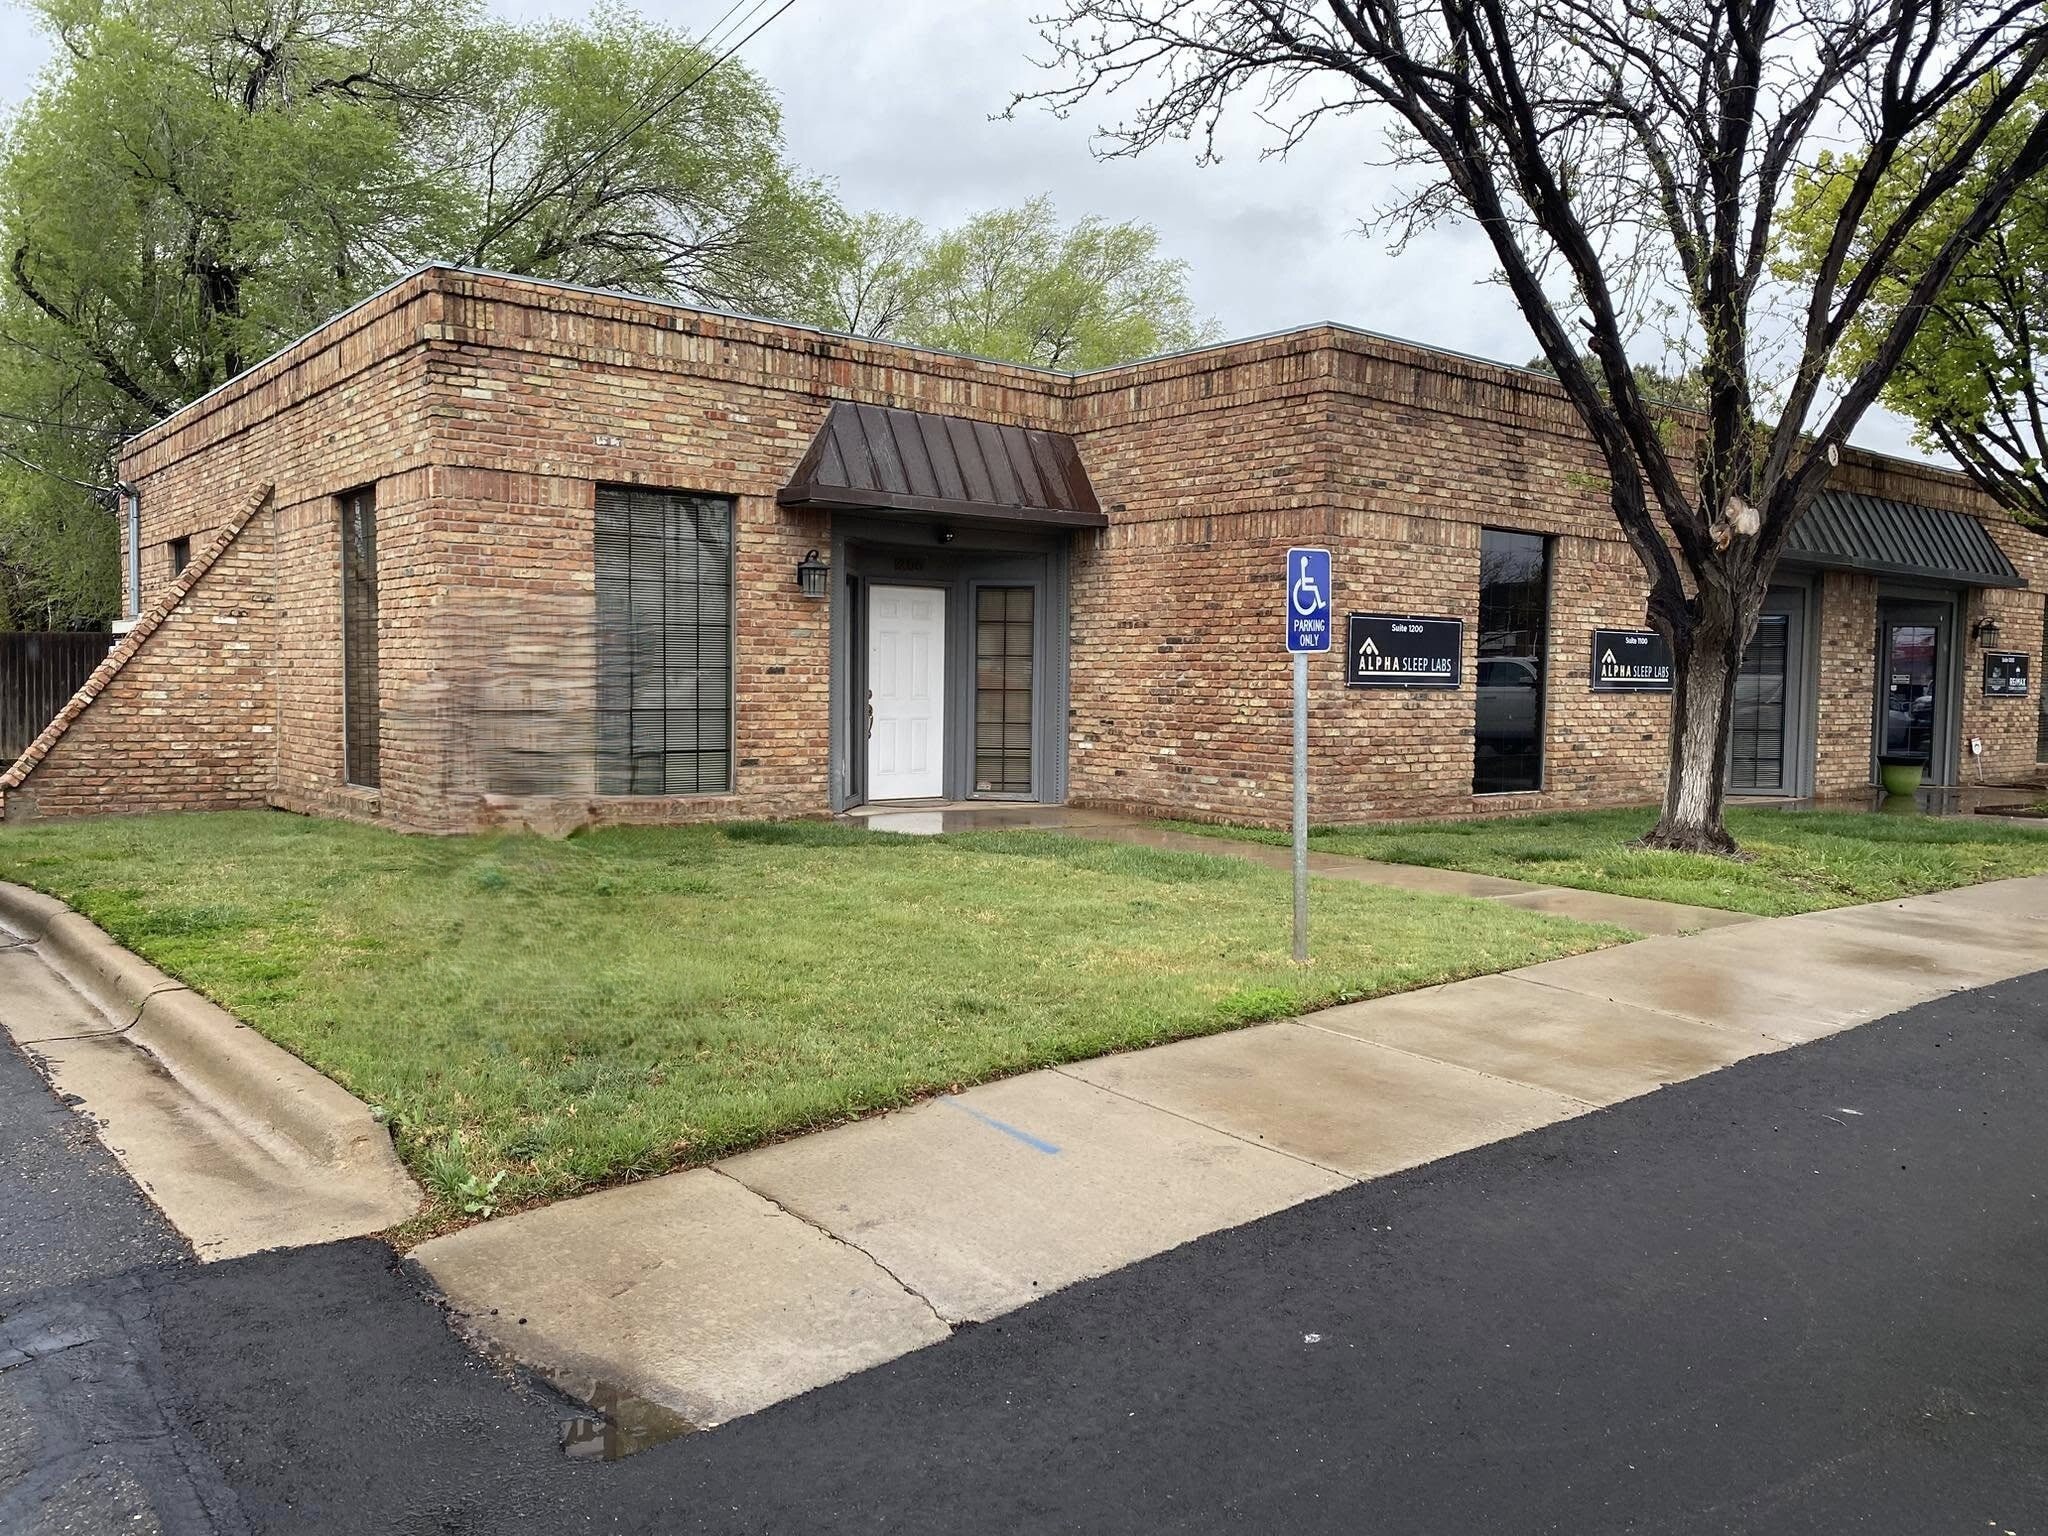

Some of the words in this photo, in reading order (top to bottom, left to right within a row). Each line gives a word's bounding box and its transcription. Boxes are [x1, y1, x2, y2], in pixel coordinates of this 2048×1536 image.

[1293, 619, 1325, 632] PARKING
[1391, 623, 1408, 632] Suite
[1408, 624, 1424, 633] 1200
[1300, 634, 1319, 647] ONLY
[1358, 656, 1400, 670] ALPHA
[1402, 657, 1428, 671] SLEEP
[1431, 658, 1452, 672] LABS
[1601, 664, 1632, 677] ALPHA
[1633, 665, 1653, 678] SLEEP
[1654, 666, 1669, 678] LABS
